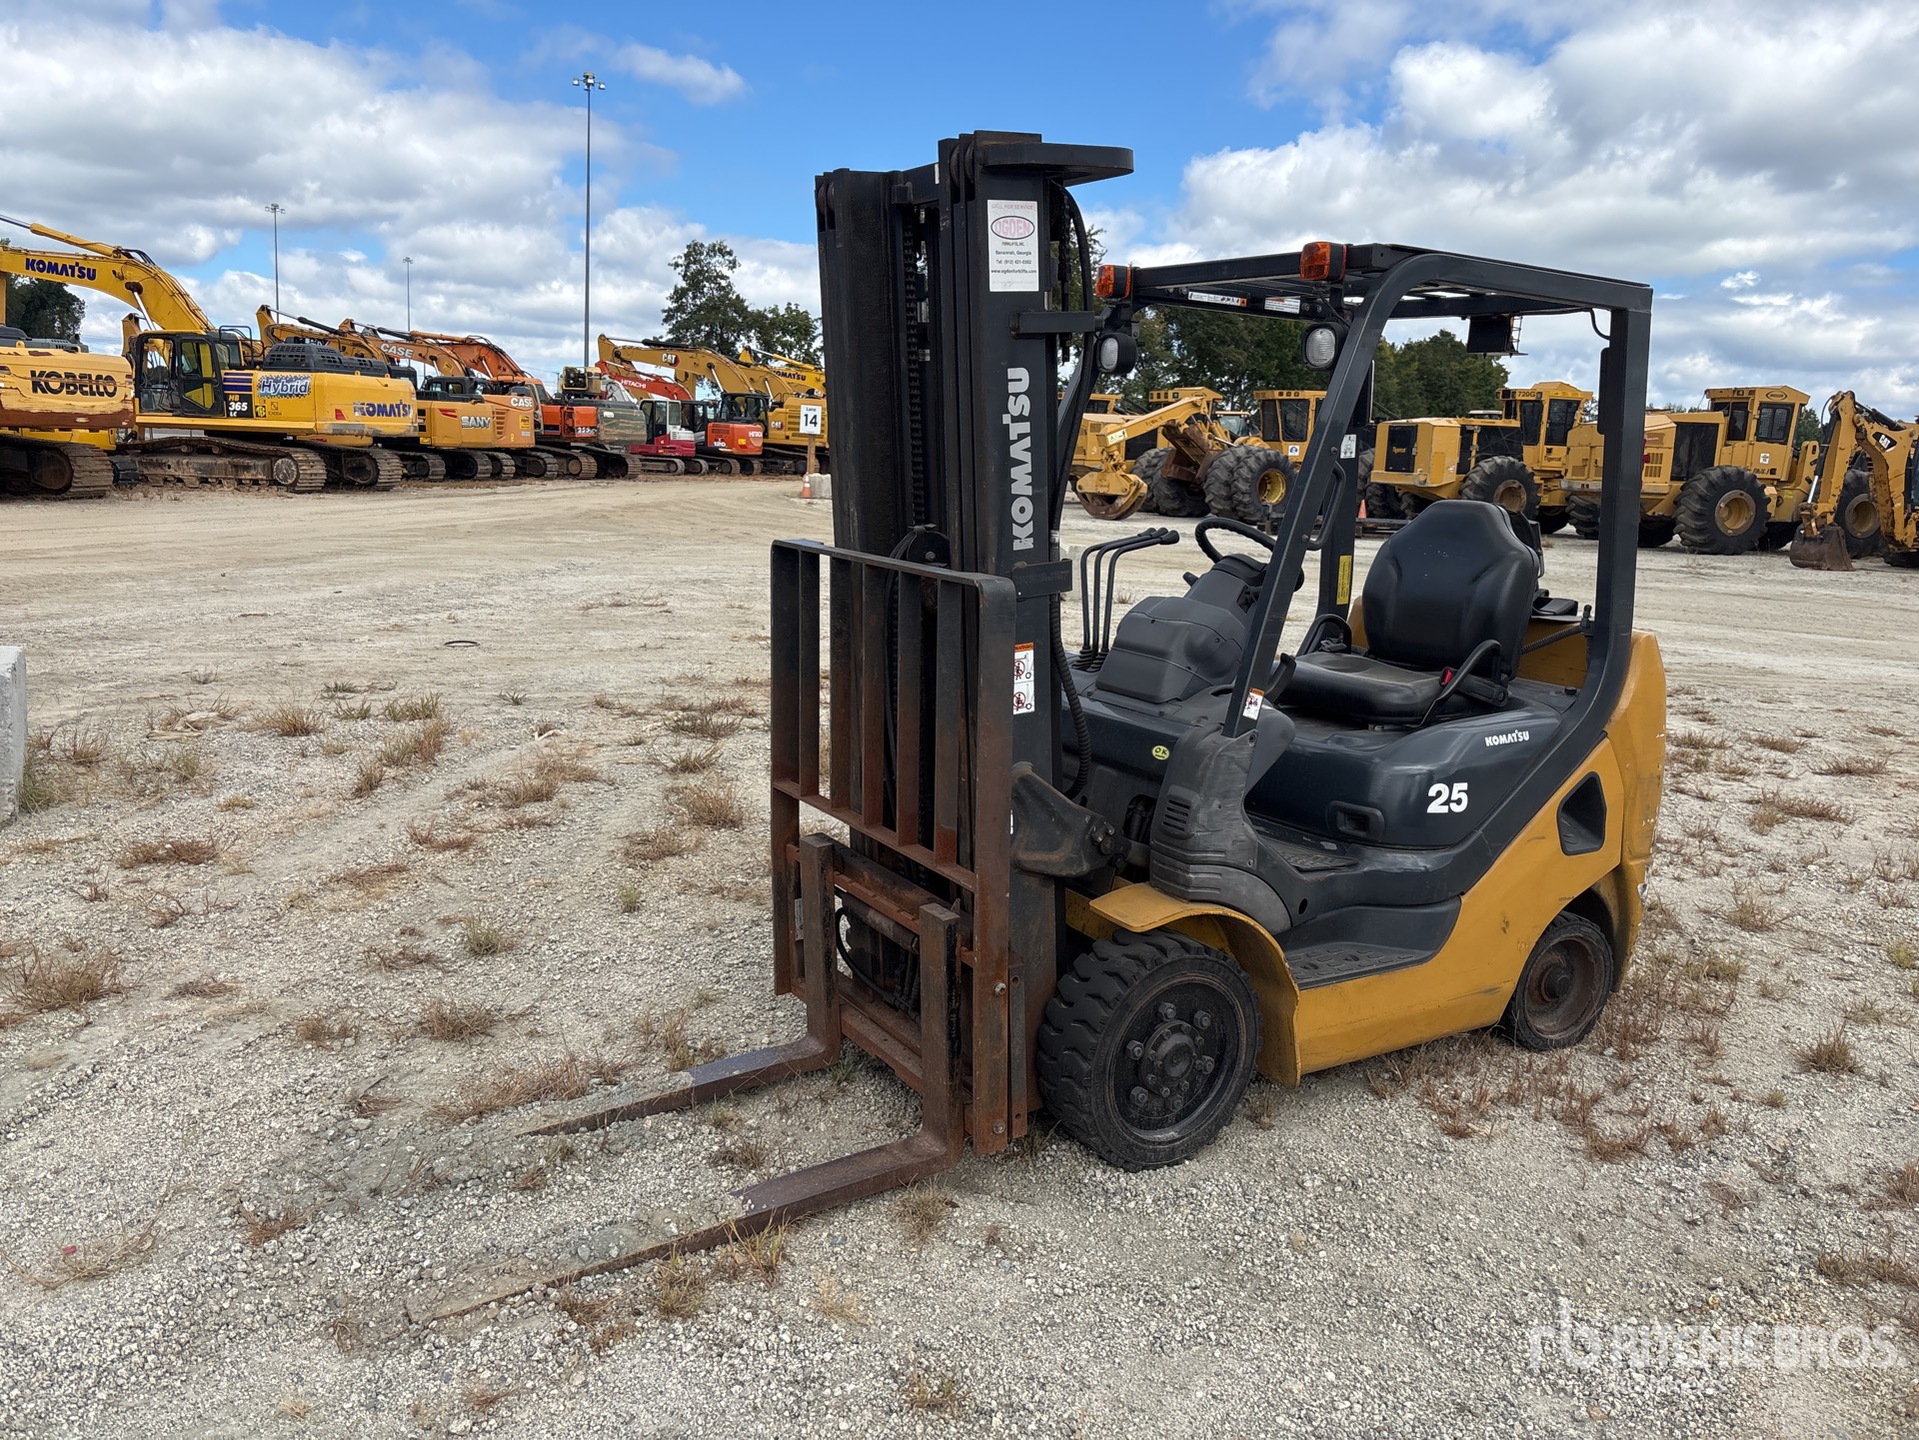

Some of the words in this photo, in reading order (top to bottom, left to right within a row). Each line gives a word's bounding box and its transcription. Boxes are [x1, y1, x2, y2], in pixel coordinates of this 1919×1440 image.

[994, 219, 1031, 237] OGDEN
[25, 257, 97, 281] KOMATSU
[380, 343, 414, 359] CASE
[662, 353, 677, 364] CAT
[30, 370, 118, 398] KOBELCO
[261, 380, 310, 396] Hybrid
[620, 379, 646, 389] HITACHI
[229, 402, 248, 411] 365
[510, 397, 533, 407] CASE
[461, 416, 491, 428] SANY
[803, 413, 818, 427] 14
[1007, 367, 1034, 551] KOMATSU
[1484, 729, 1530, 747] KOMATSU
[1154, 746, 1168, 756] OK
[1426, 782, 1469, 814] 25
